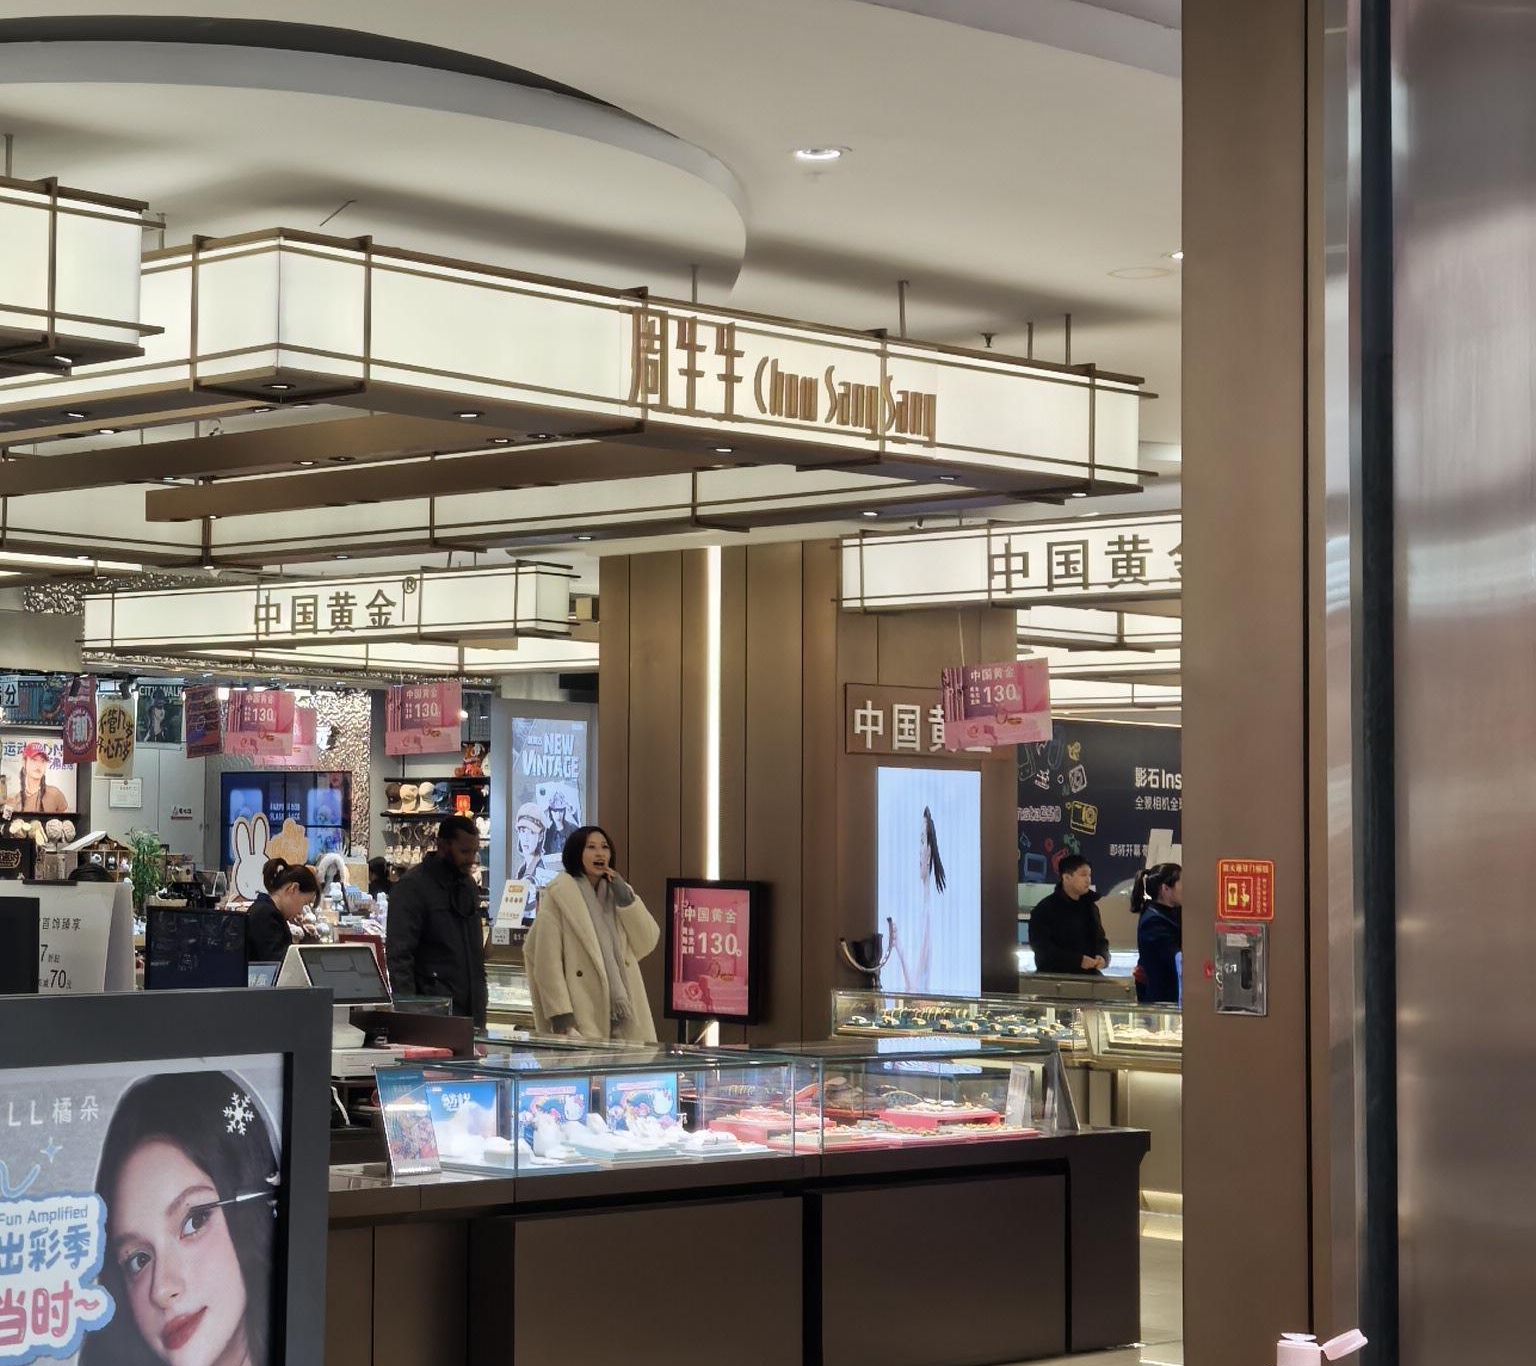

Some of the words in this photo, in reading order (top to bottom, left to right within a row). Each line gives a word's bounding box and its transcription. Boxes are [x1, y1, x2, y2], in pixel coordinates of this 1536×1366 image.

[629, 306, 745, 422] 周生生
[544, 733, 575, 756] NEW
[522, 749, 581, 780] VINTAGE
[52, 1095, 99, 1124] 橘朵
[27, 1204, 89, 1228] Amplified
